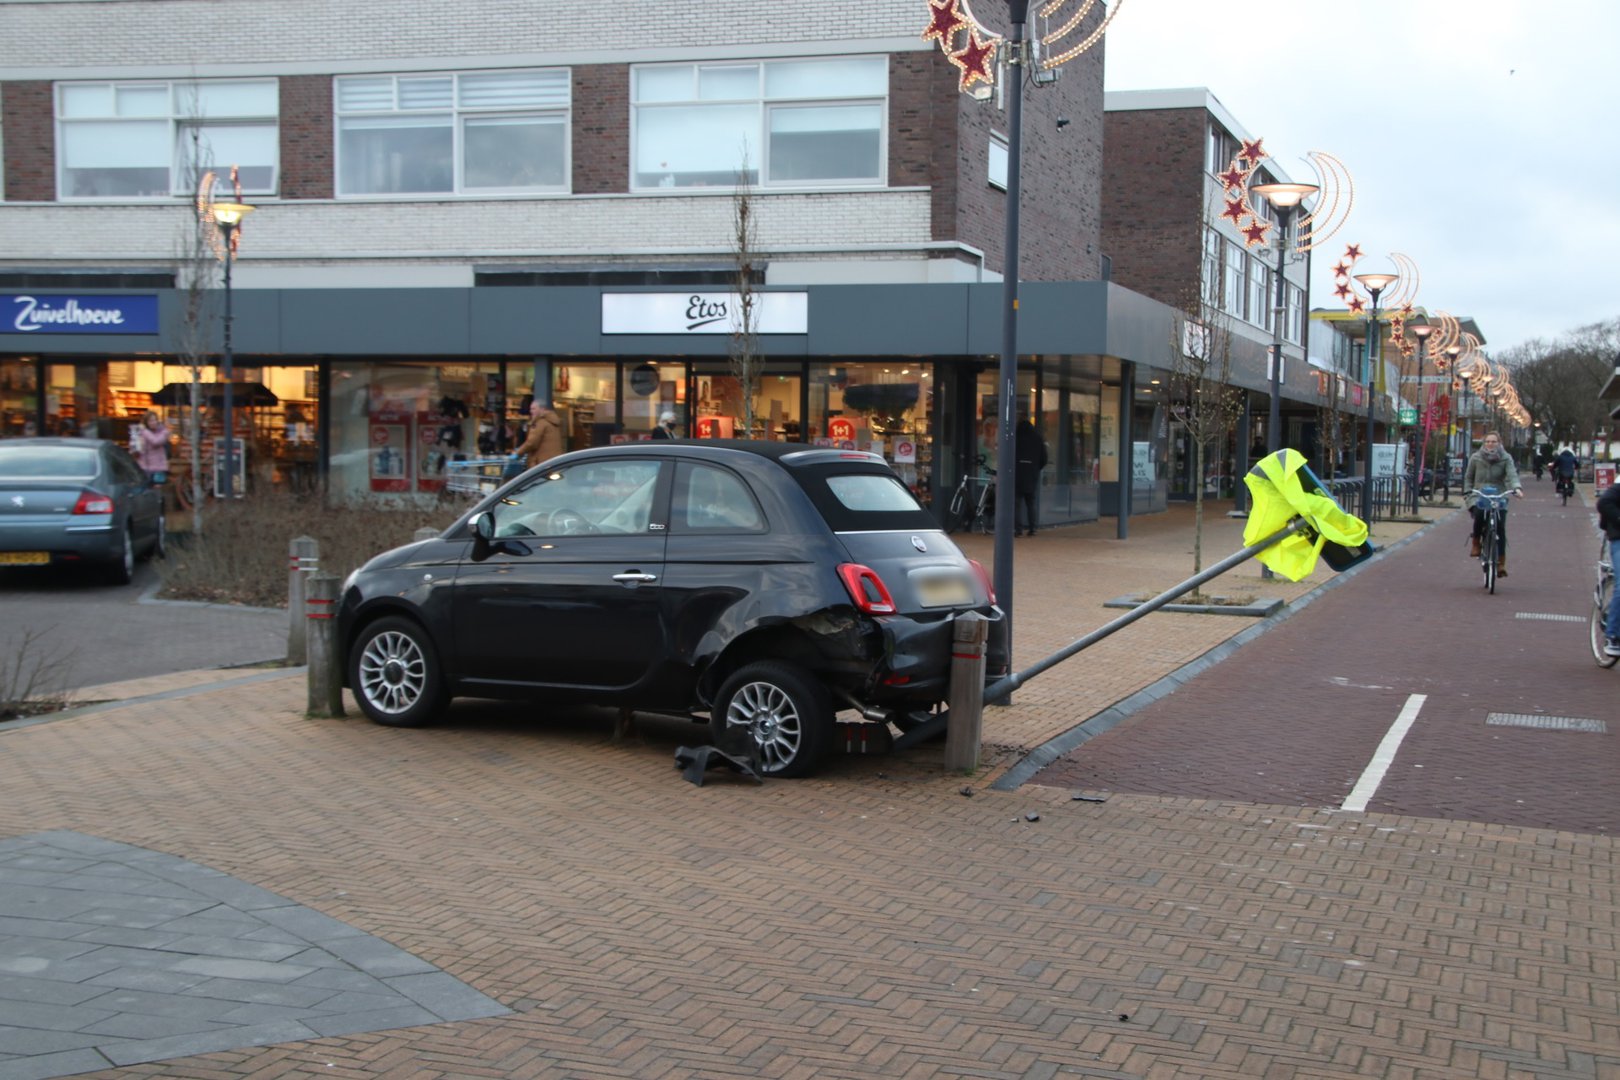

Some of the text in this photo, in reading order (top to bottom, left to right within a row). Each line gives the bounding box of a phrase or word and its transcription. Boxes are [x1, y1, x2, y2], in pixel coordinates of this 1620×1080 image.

[14, 296, 125, 331] Zuivelhoeve
[686, 295, 727, 321] Etos
[832, 425, 849, 436] 1+1
